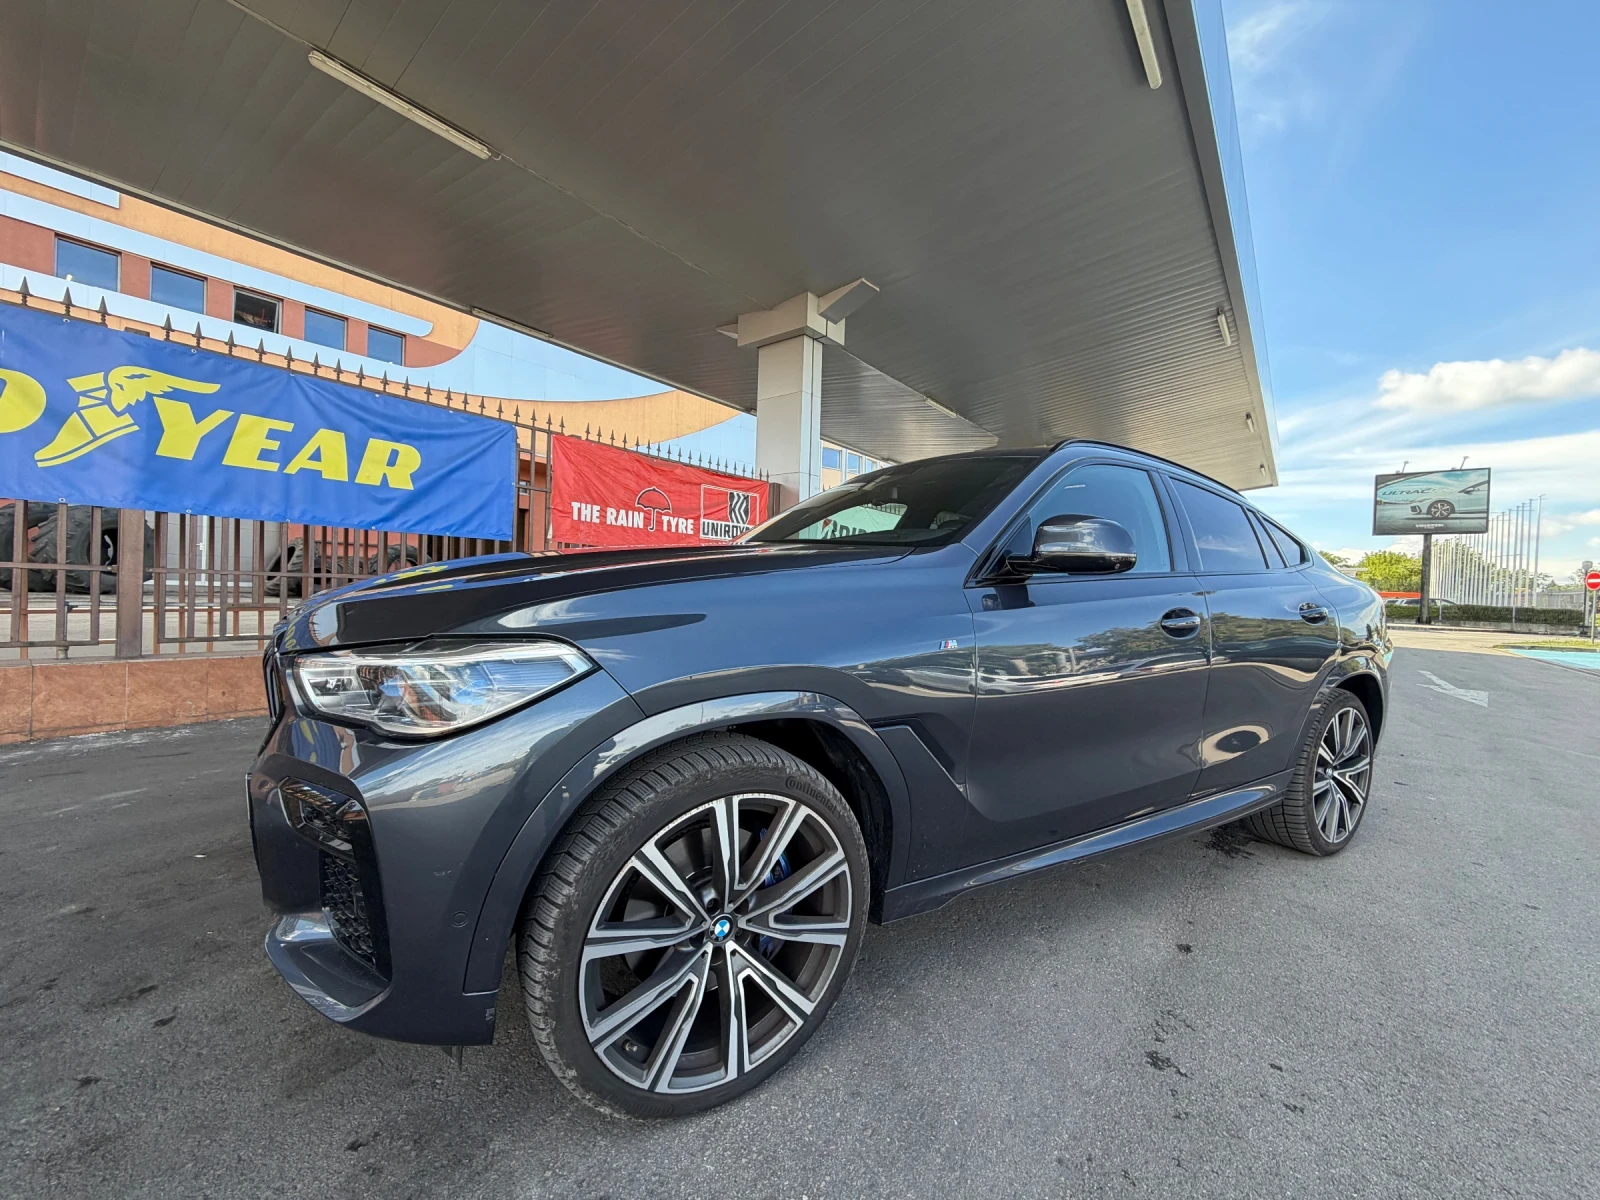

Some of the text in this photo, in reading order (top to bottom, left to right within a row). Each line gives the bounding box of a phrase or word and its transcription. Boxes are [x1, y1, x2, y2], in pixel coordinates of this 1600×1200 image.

[152, 396, 422, 491] YEAR
[571, 501, 694, 535] THE RAIN TYRE
[784, 775, 838, 814] Continental
